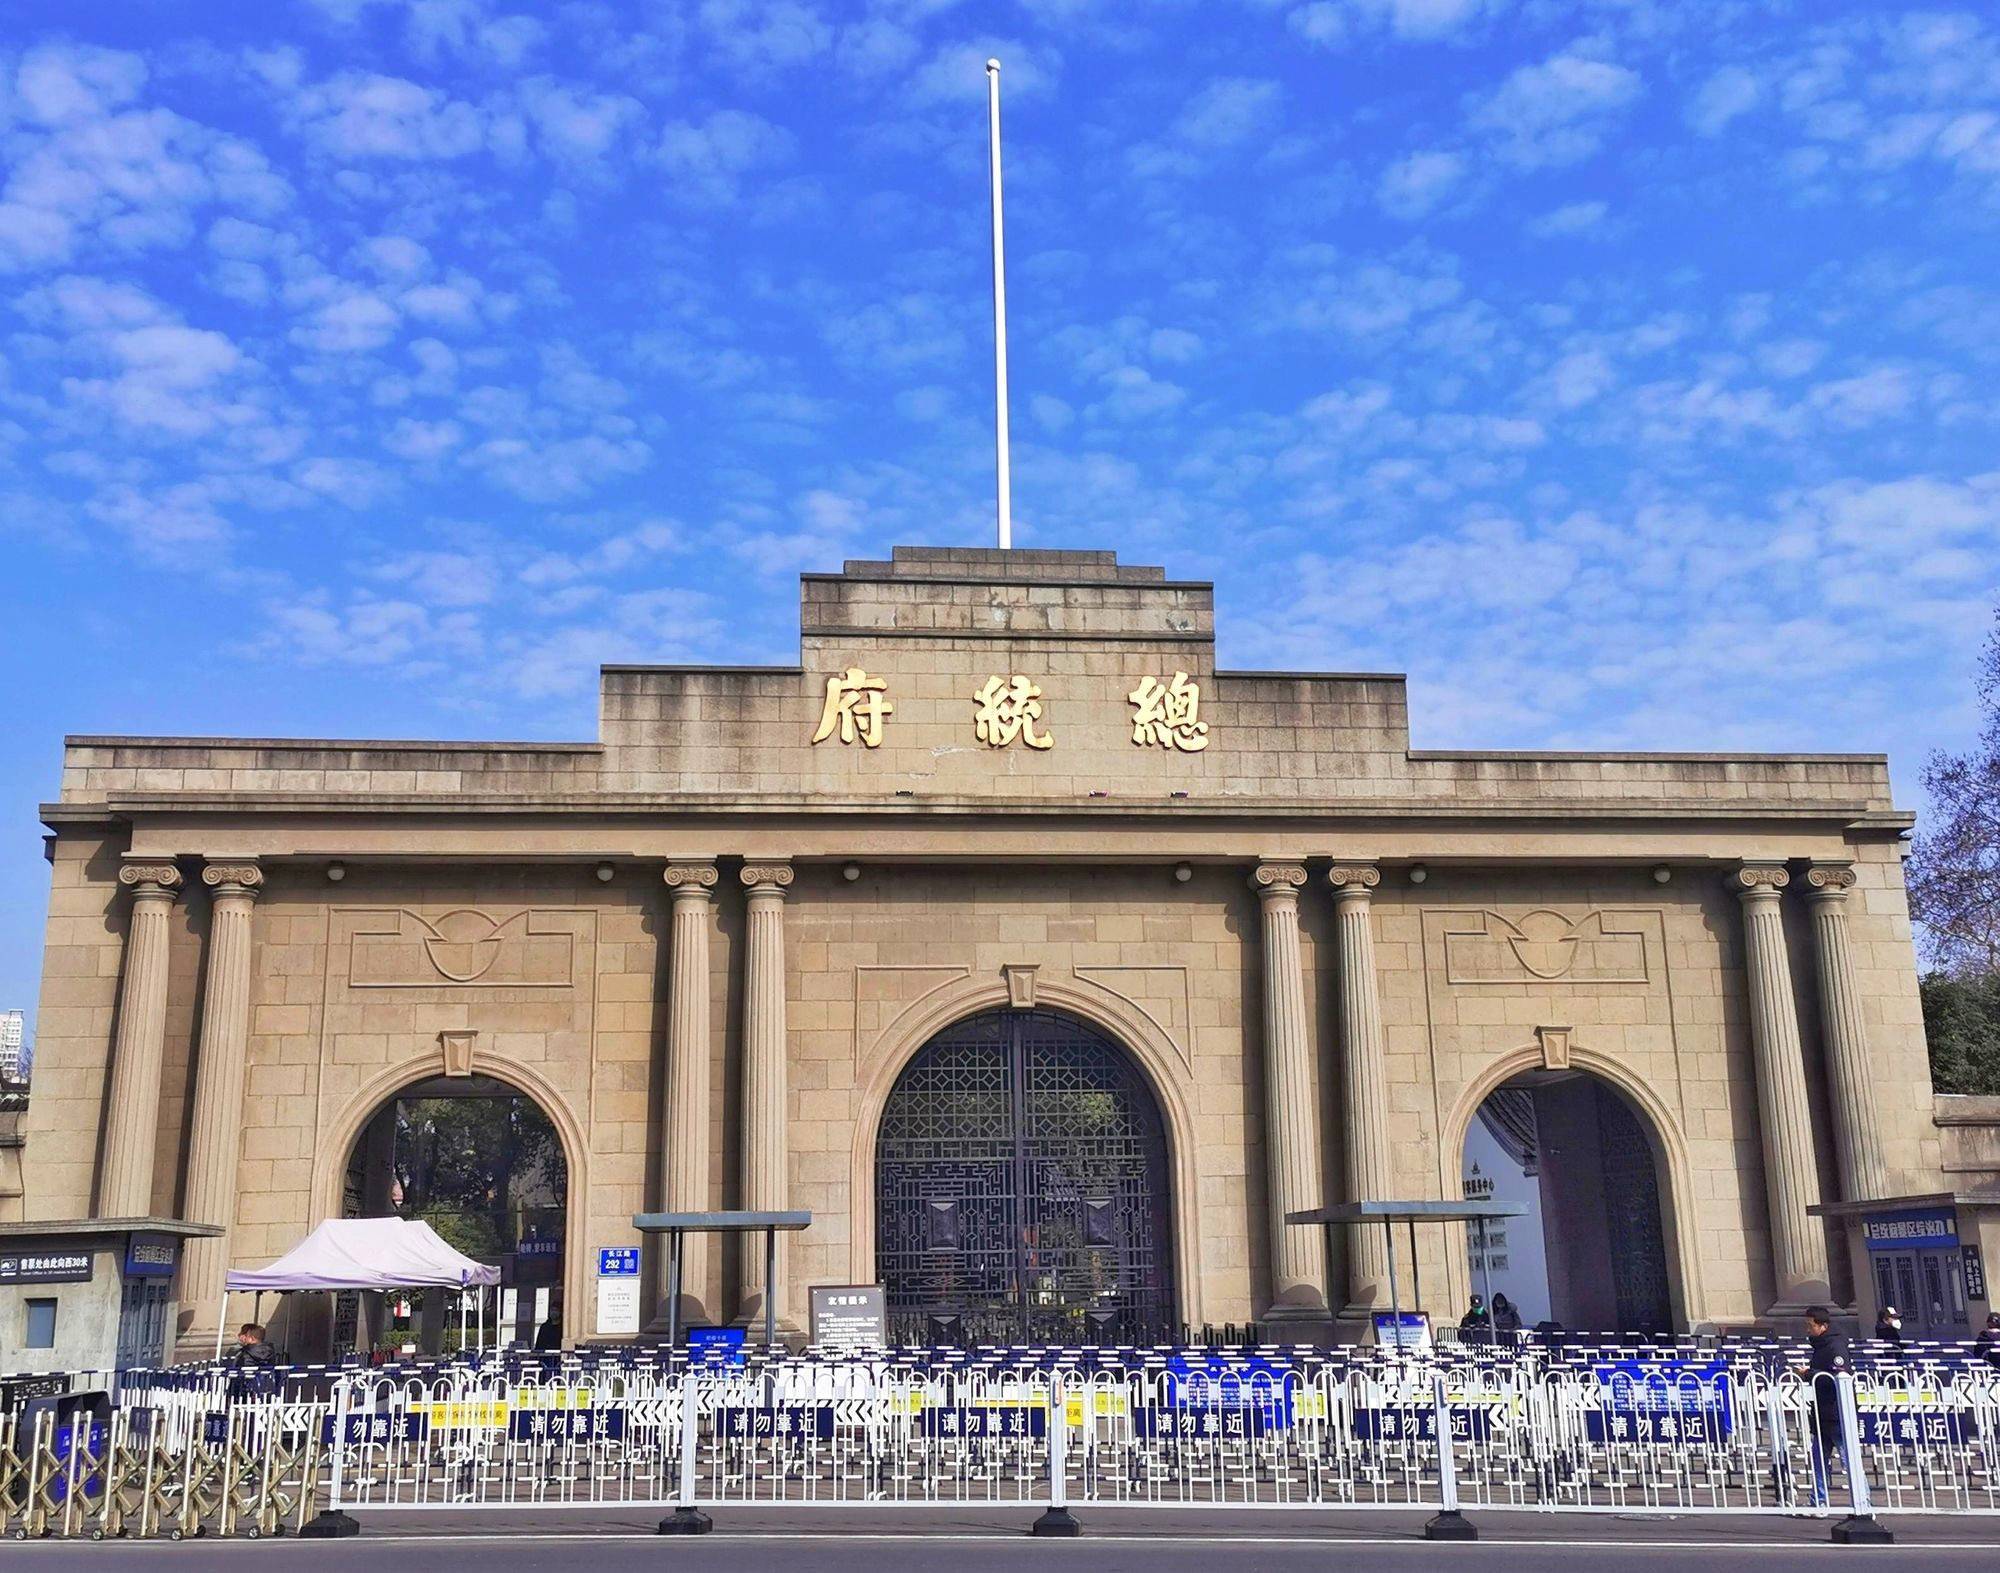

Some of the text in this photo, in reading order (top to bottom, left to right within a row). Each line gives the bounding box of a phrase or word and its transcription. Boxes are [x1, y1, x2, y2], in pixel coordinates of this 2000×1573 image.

[605, 1258, 620, 1270] 292
[530, 1411, 609, 1434] 请勿靠近
[734, 1410, 815, 1432] 请勿靠近
[942, 1412, 1026, 1433] 请勿靠近
[1157, 1412, 1244, 1433] 请勿靠近
[1611, 1414, 1704, 1438] 请勿靠近
